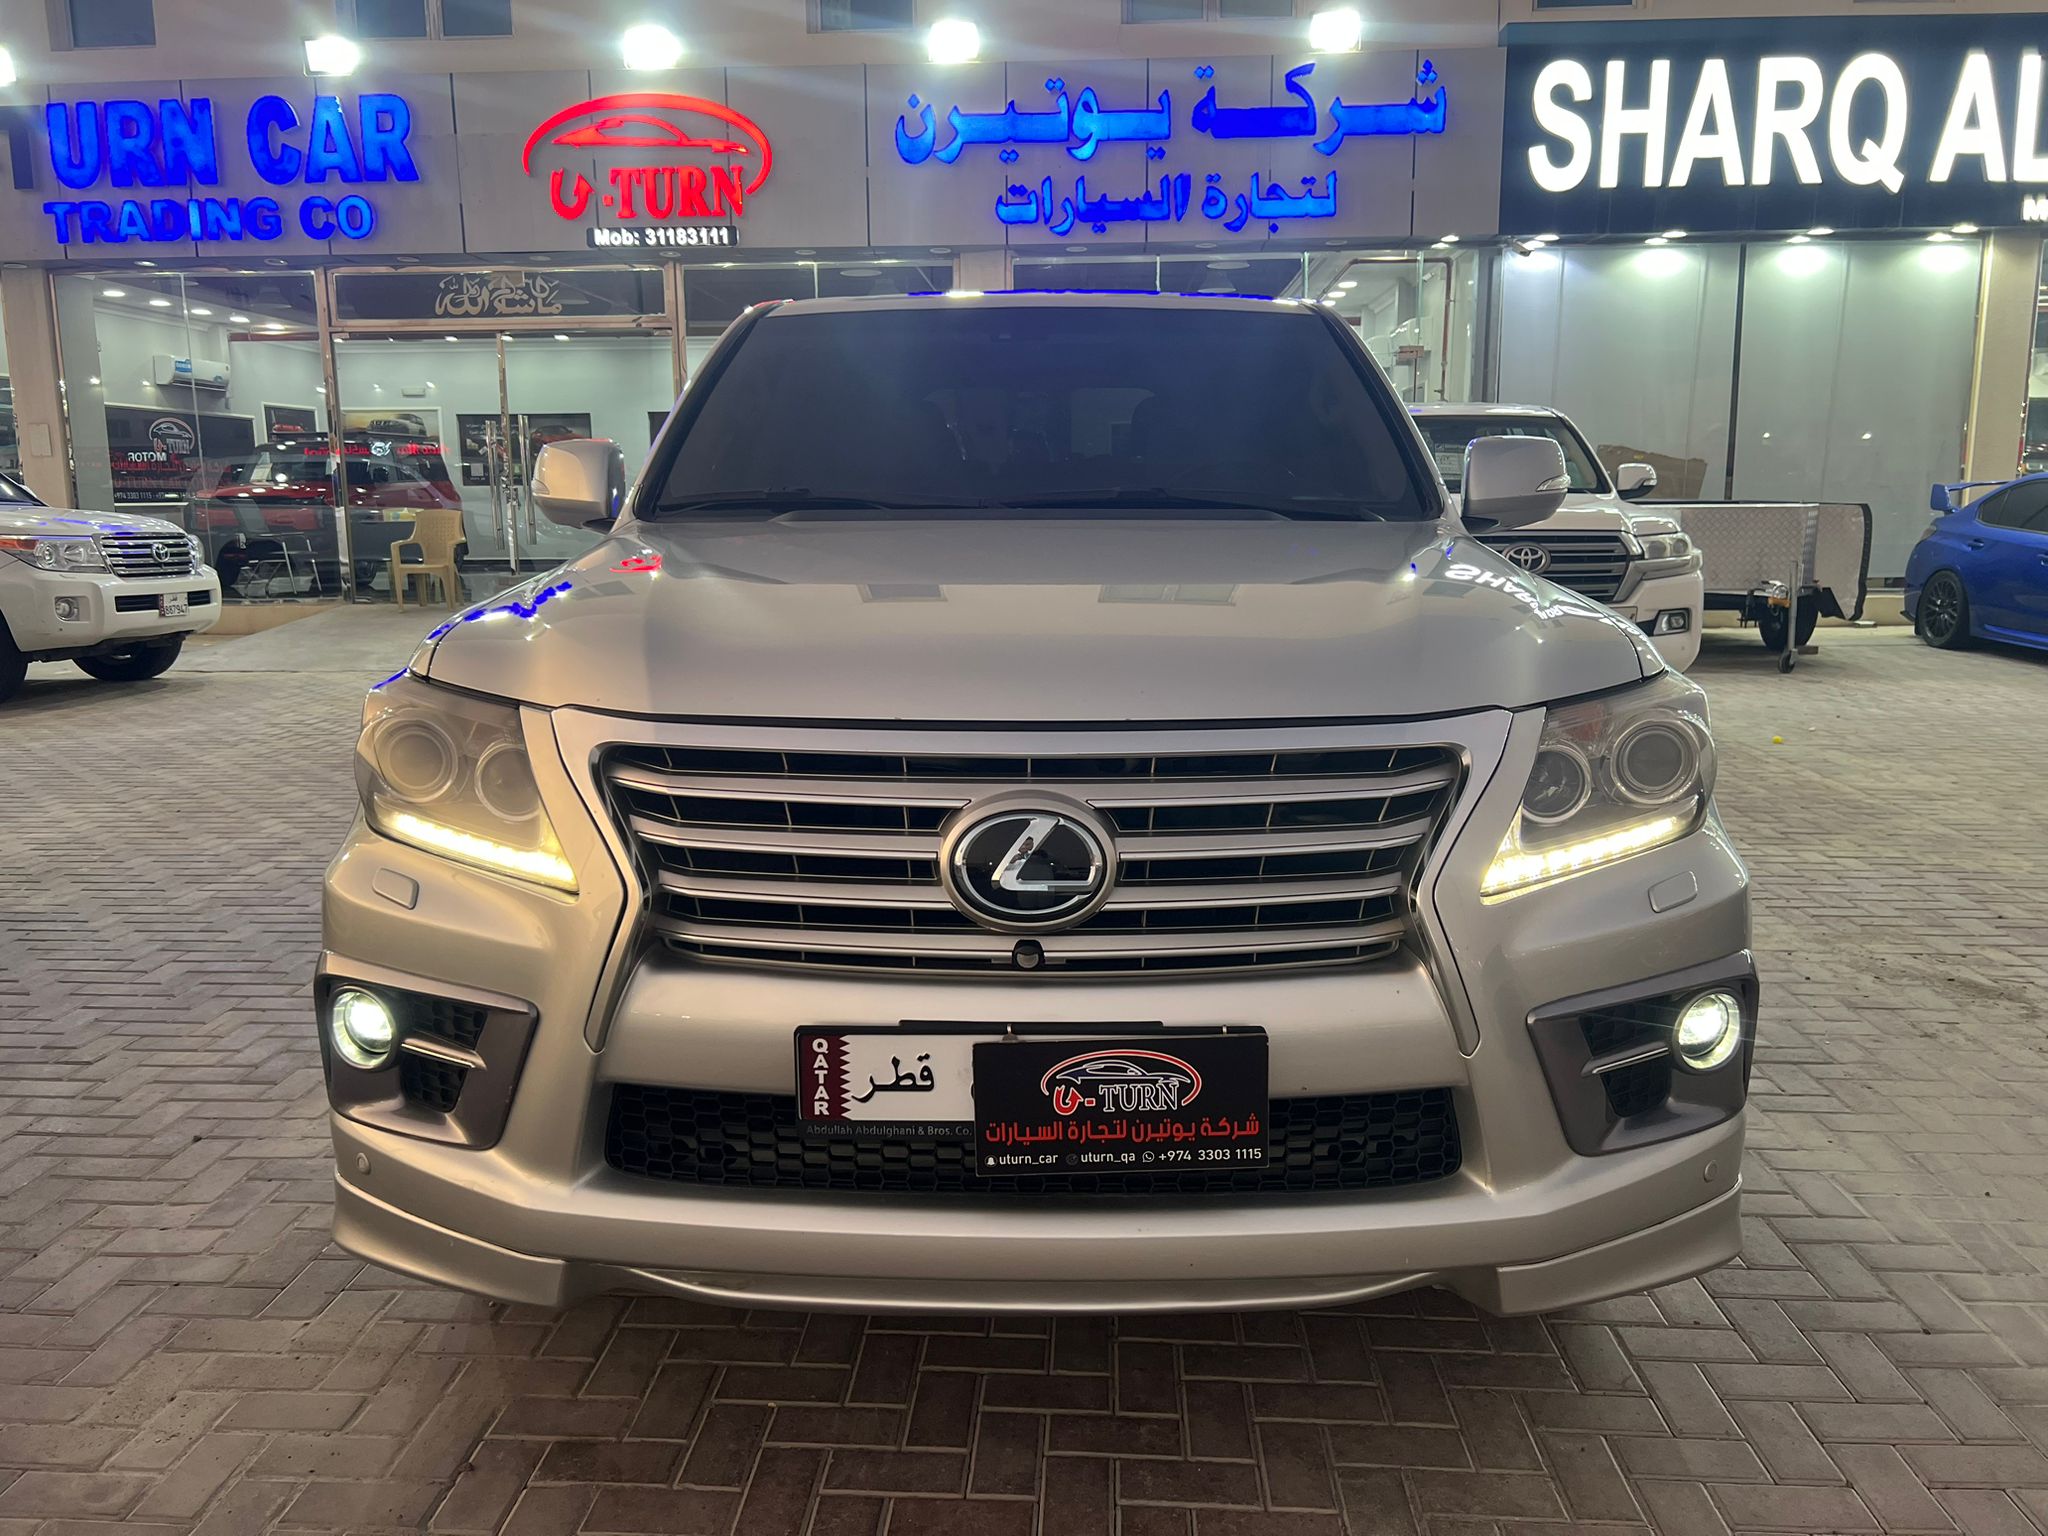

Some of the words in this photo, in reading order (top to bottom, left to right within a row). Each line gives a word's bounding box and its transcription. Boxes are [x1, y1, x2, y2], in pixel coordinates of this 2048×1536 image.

[895, 77, 1171, 164] يوتيرن
[1192, 59, 1447, 156] شركة
[1528, 52, 1908, 194] SHARQ
[246, 94, 419, 185] CAR
[43, 197, 283, 244] TRADING
[300, 195, 374, 240] CO
[995, 172, 1192, 235] السيارات
[1201, 169, 1337, 233] لتجارة
[594, 228, 640, 246] Mob:
[645, 227, 730, 246] 31183111
[812, 1038, 830, 1116] QATAR
[851, 1053, 935, 1103] قطر
[807, 1125, 852, 1136] Abdullah
[856, 1125, 915, 1138] Abdulghani
[918, 1127, 925, 1136] &
[928, 1126, 953, 1136] Bros.
[955, 1126, 973, 1136] Co.
[986, 1121, 1063, 1146] السيارات
[1067, 1119, 1127, 1144] لتجارة
[1131, 1118, 1196, 1143] يوتيرن
[1200, 1113, 1260, 1139] شركة
[999, 1154, 1058, 1165] uturn_car
[1081, 1152, 1136, 1164] uturn_qa
[1159, 1150, 1192, 1161] +974
[1198, 1149, 1230, 1160] 3303
[1236, 1148, 1262, 1160] 1115
